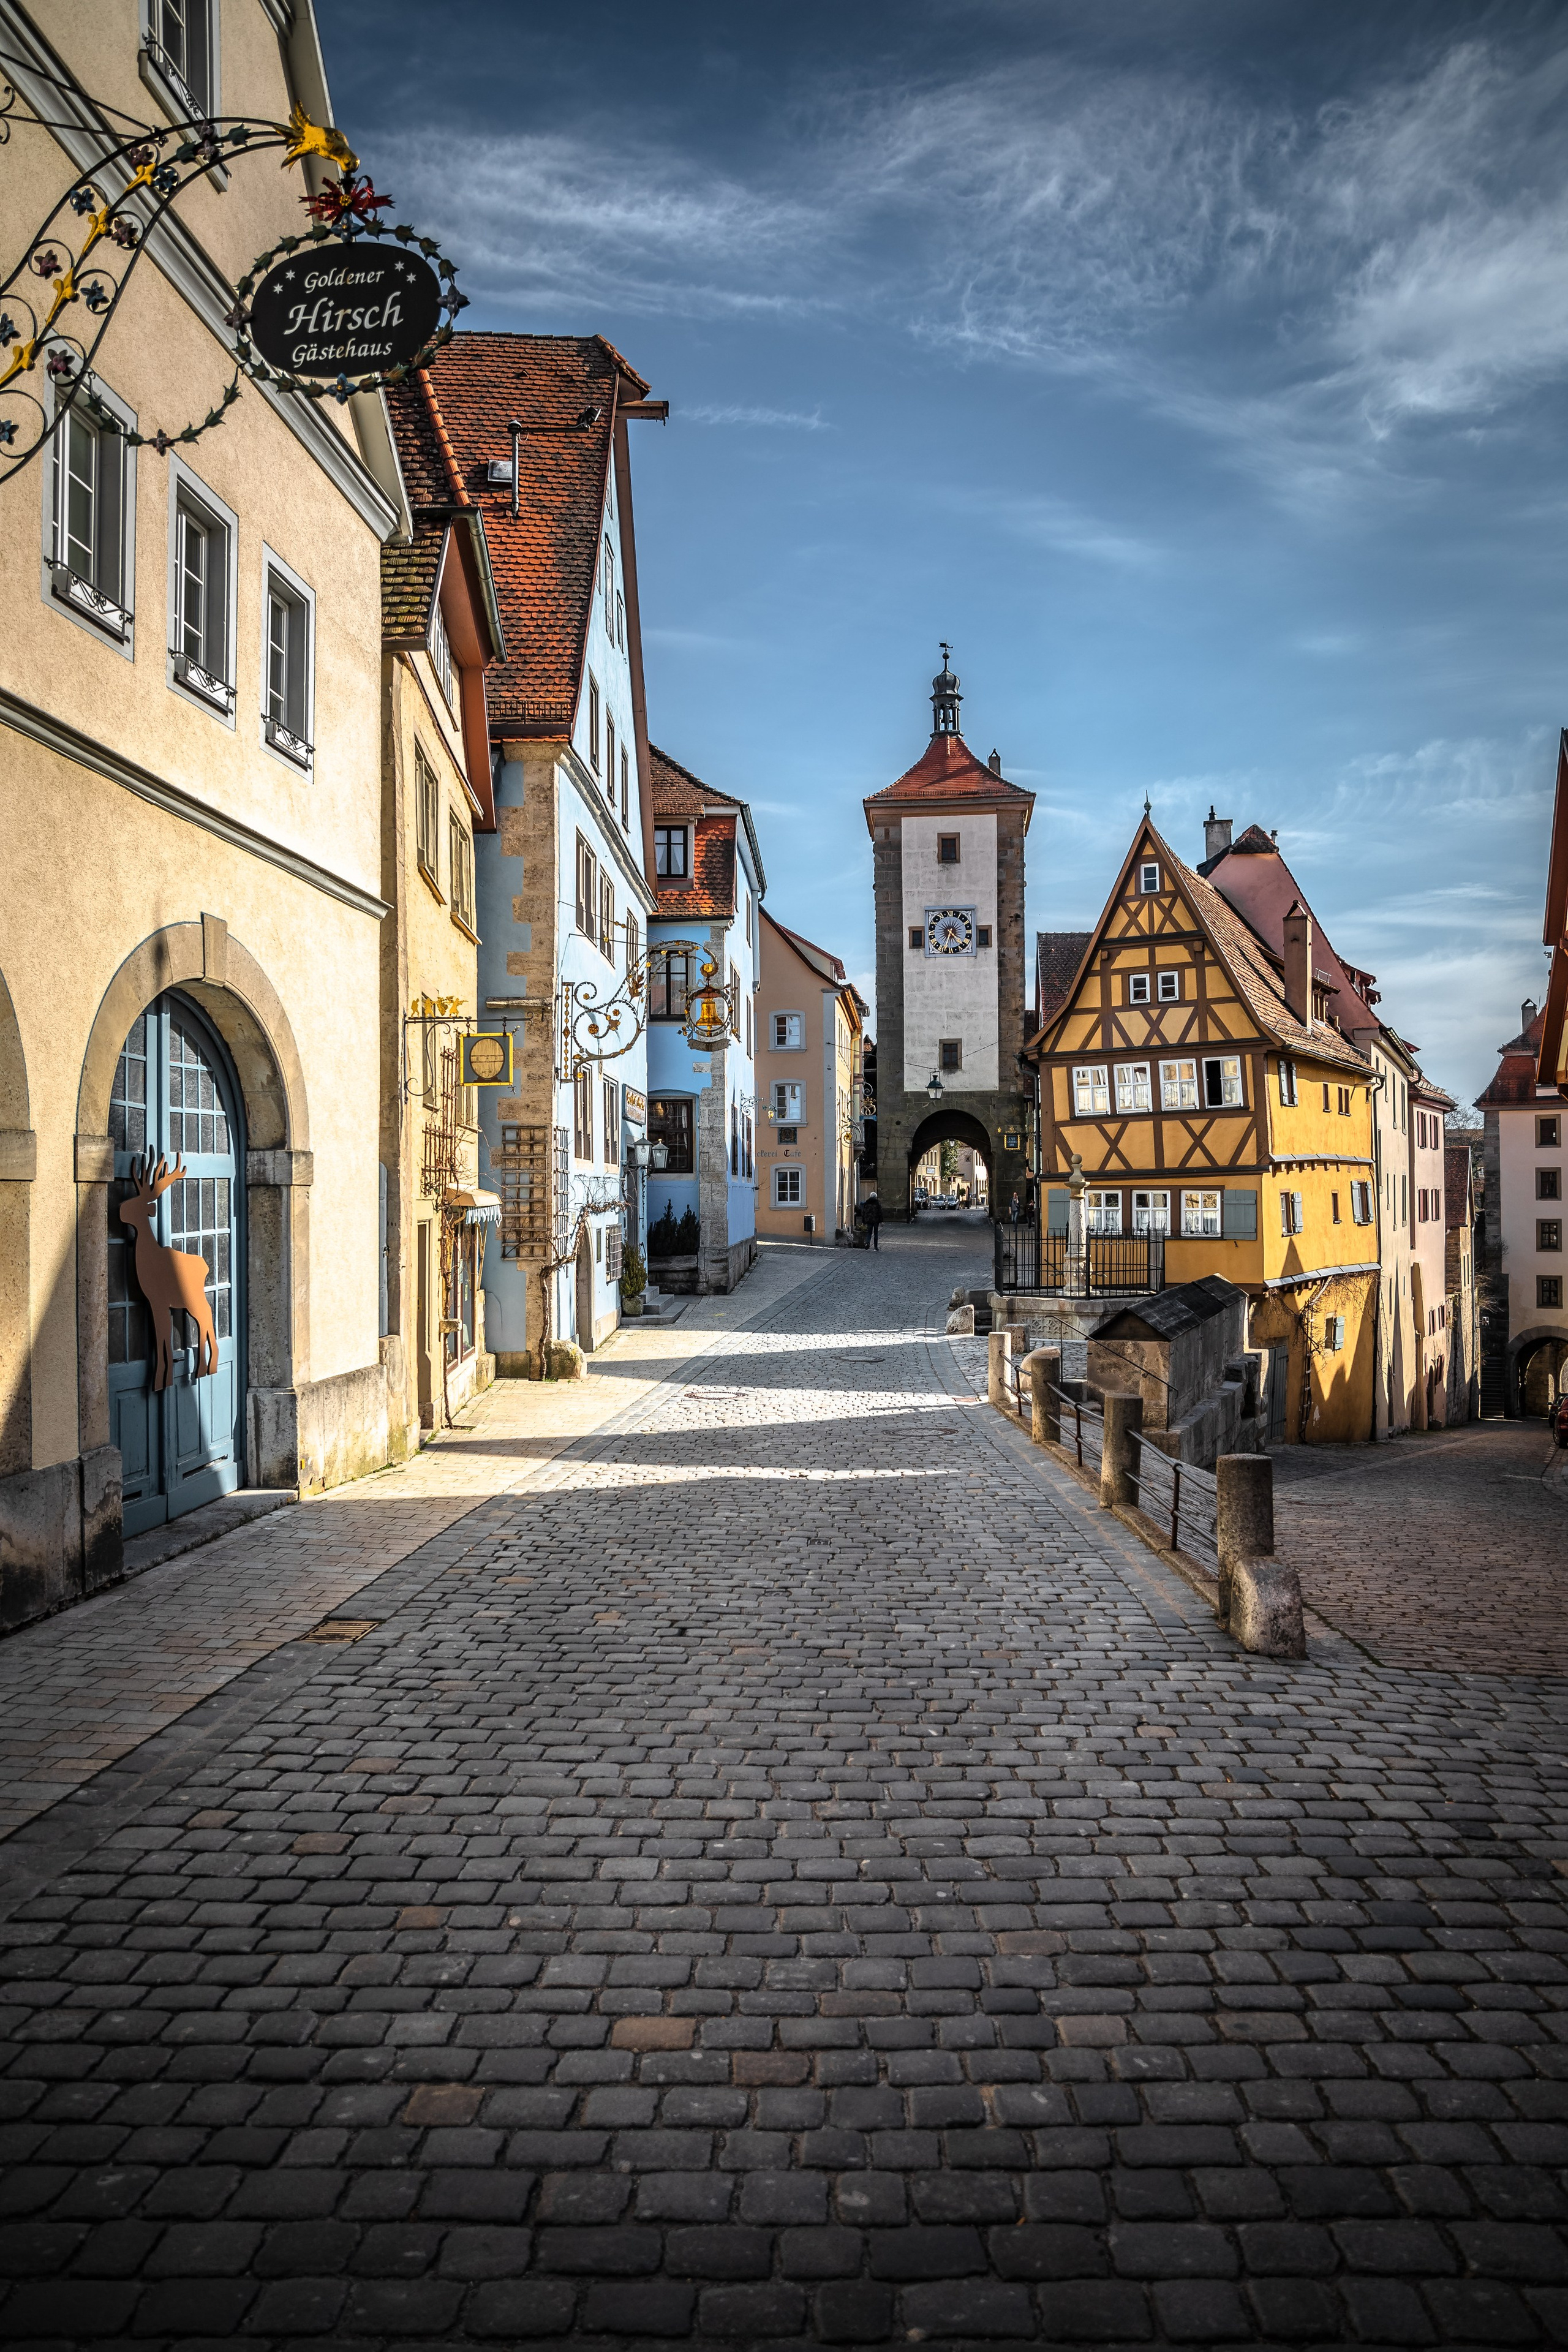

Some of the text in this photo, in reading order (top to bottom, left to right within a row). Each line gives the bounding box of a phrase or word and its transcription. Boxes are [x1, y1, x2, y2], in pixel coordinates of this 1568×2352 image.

[304, 267, 385, 294] Goldener
[283, 291, 404, 335] Hirsch
[292, 338, 393, 369] Gästehaus
